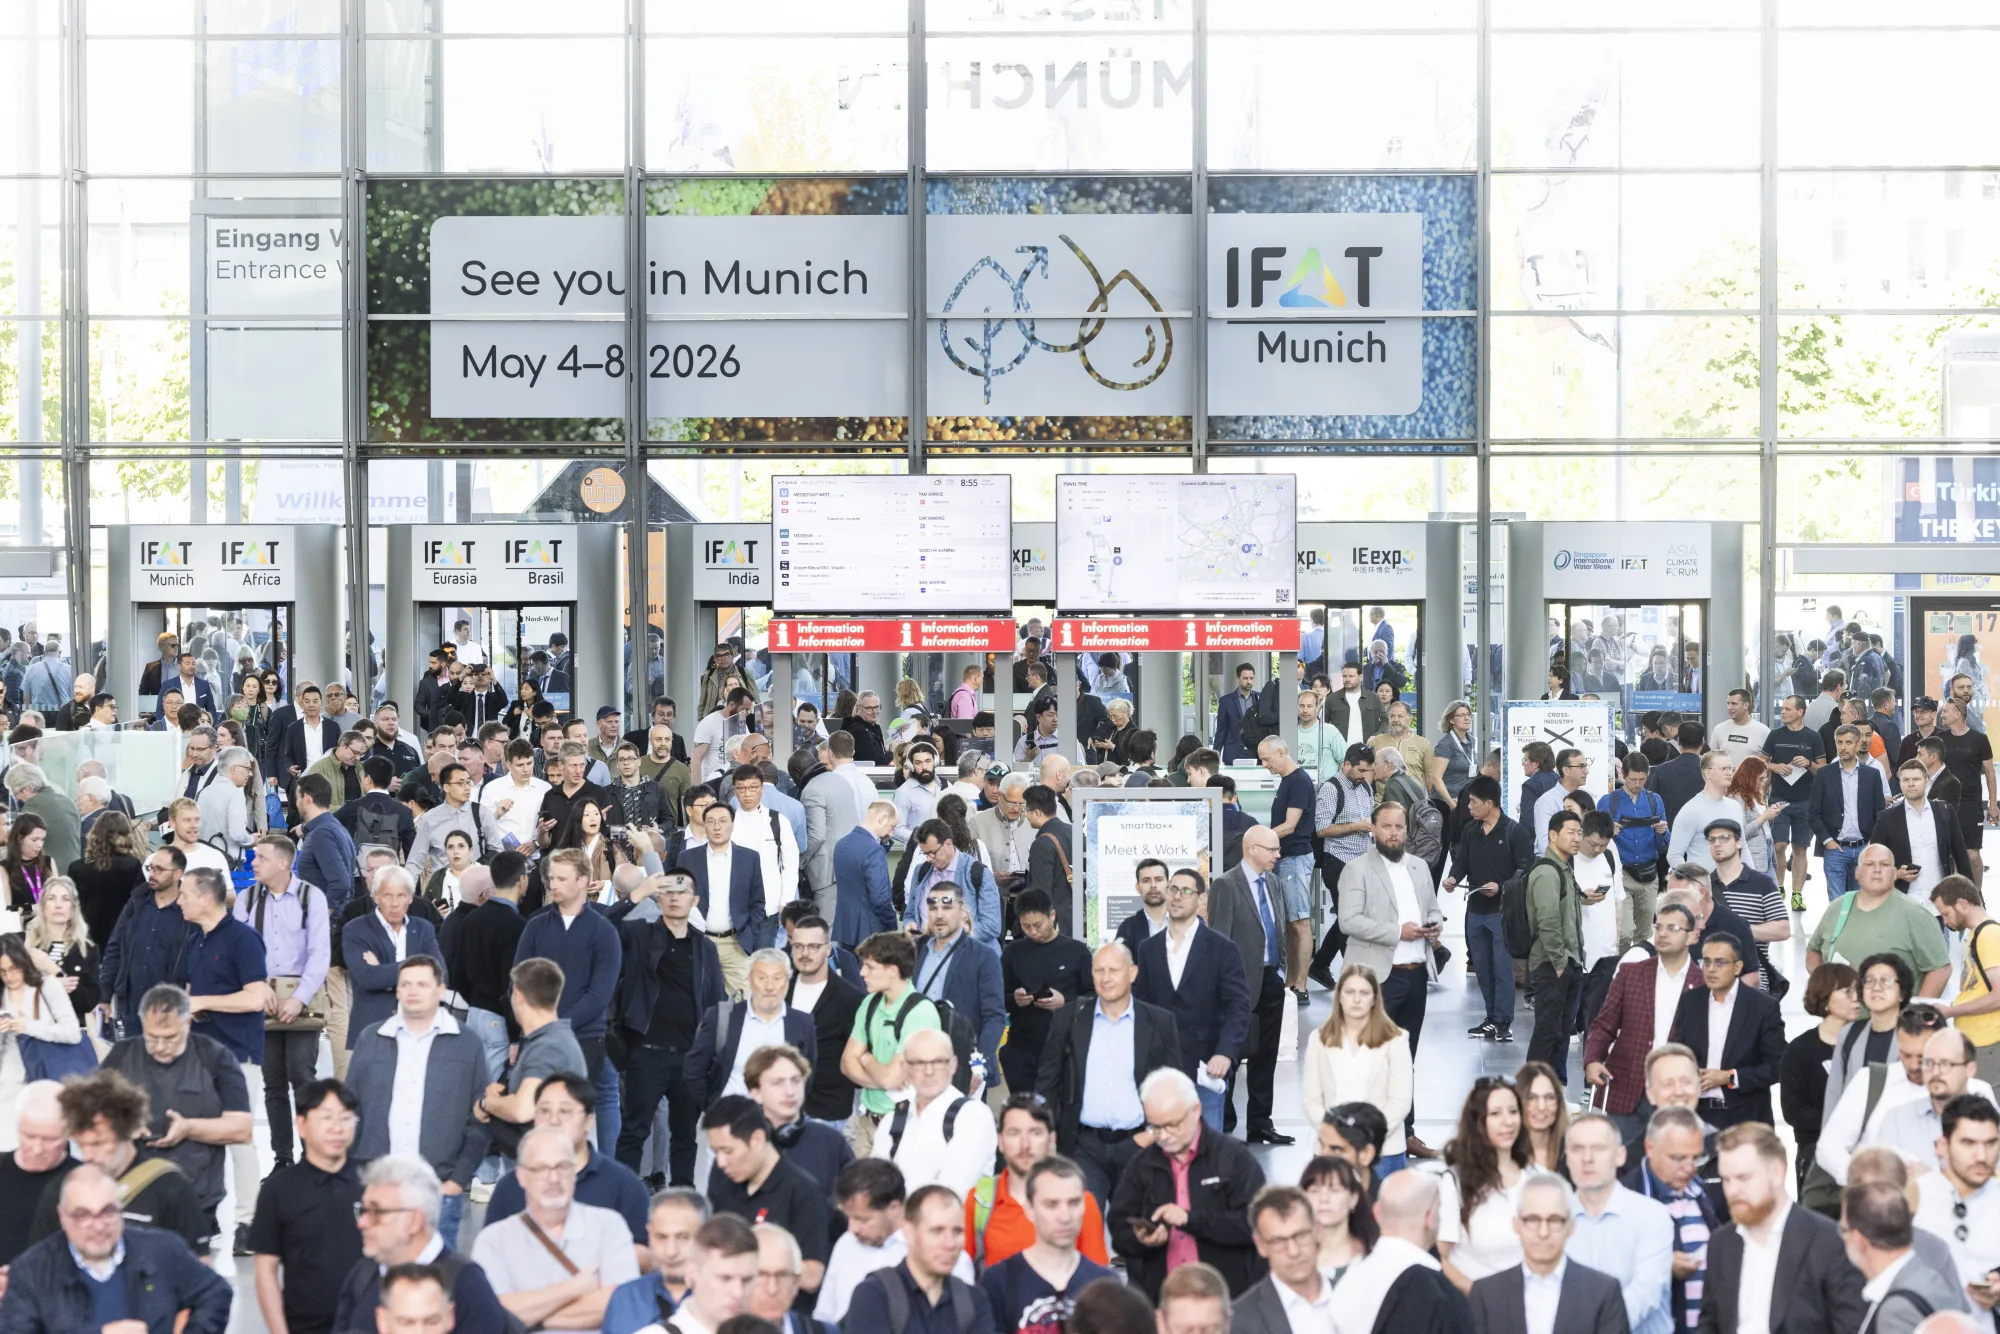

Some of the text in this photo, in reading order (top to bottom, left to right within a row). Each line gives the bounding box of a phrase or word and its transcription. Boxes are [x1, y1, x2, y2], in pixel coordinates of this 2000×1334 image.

[216, 229, 320, 252] Eingang
[216, 260, 327, 279] Entrance
[460, 260, 868, 306] See you in Munich
[1226, 246, 1383, 308] IFAT
[1257, 331, 1386, 364] Munich
[462, 344, 547, 388] May
[649, 344, 741, 379] 2026
[960, 478, 979, 487] 8:55
[141, 541, 193, 565] IFAT
[222, 541, 280, 565] IFAT
[424, 540, 476, 564] IFAT
[505, 540, 563, 564] IFAT
[705, 540, 759, 564] IFAT
[1666, 544, 1698, 557] ASIA
[1621, 559, 1648, 570] IFAT
[433, 572, 477, 585] Eurasia
[528, 571, 564, 585] Brasil
[728, 571, 760, 585] India
[1666, 568, 1698, 576] FORUM
[150, 572, 194, 586] Munich
[242, 572, 281, 586] Africa
[797, 622, 865, 634] Information
[921, 622, 989, 634] Information
[1081, 622, 1149, 633] Information
[1205, 621, 1273, 633] Information
[797, 635, 865, 647] Information
[921, 635, 989, 647] Information
[1081, 635, 1150, 647] Information
[1205, 634, 1274, 647] Information
[1513, 726, 1536, 735] IFAT
[1580, 726, 1602, 735] IFAT
[1120, 822, 1173, 830] smartboxx
[1104, 844, 1189, 855] Meet & Work
